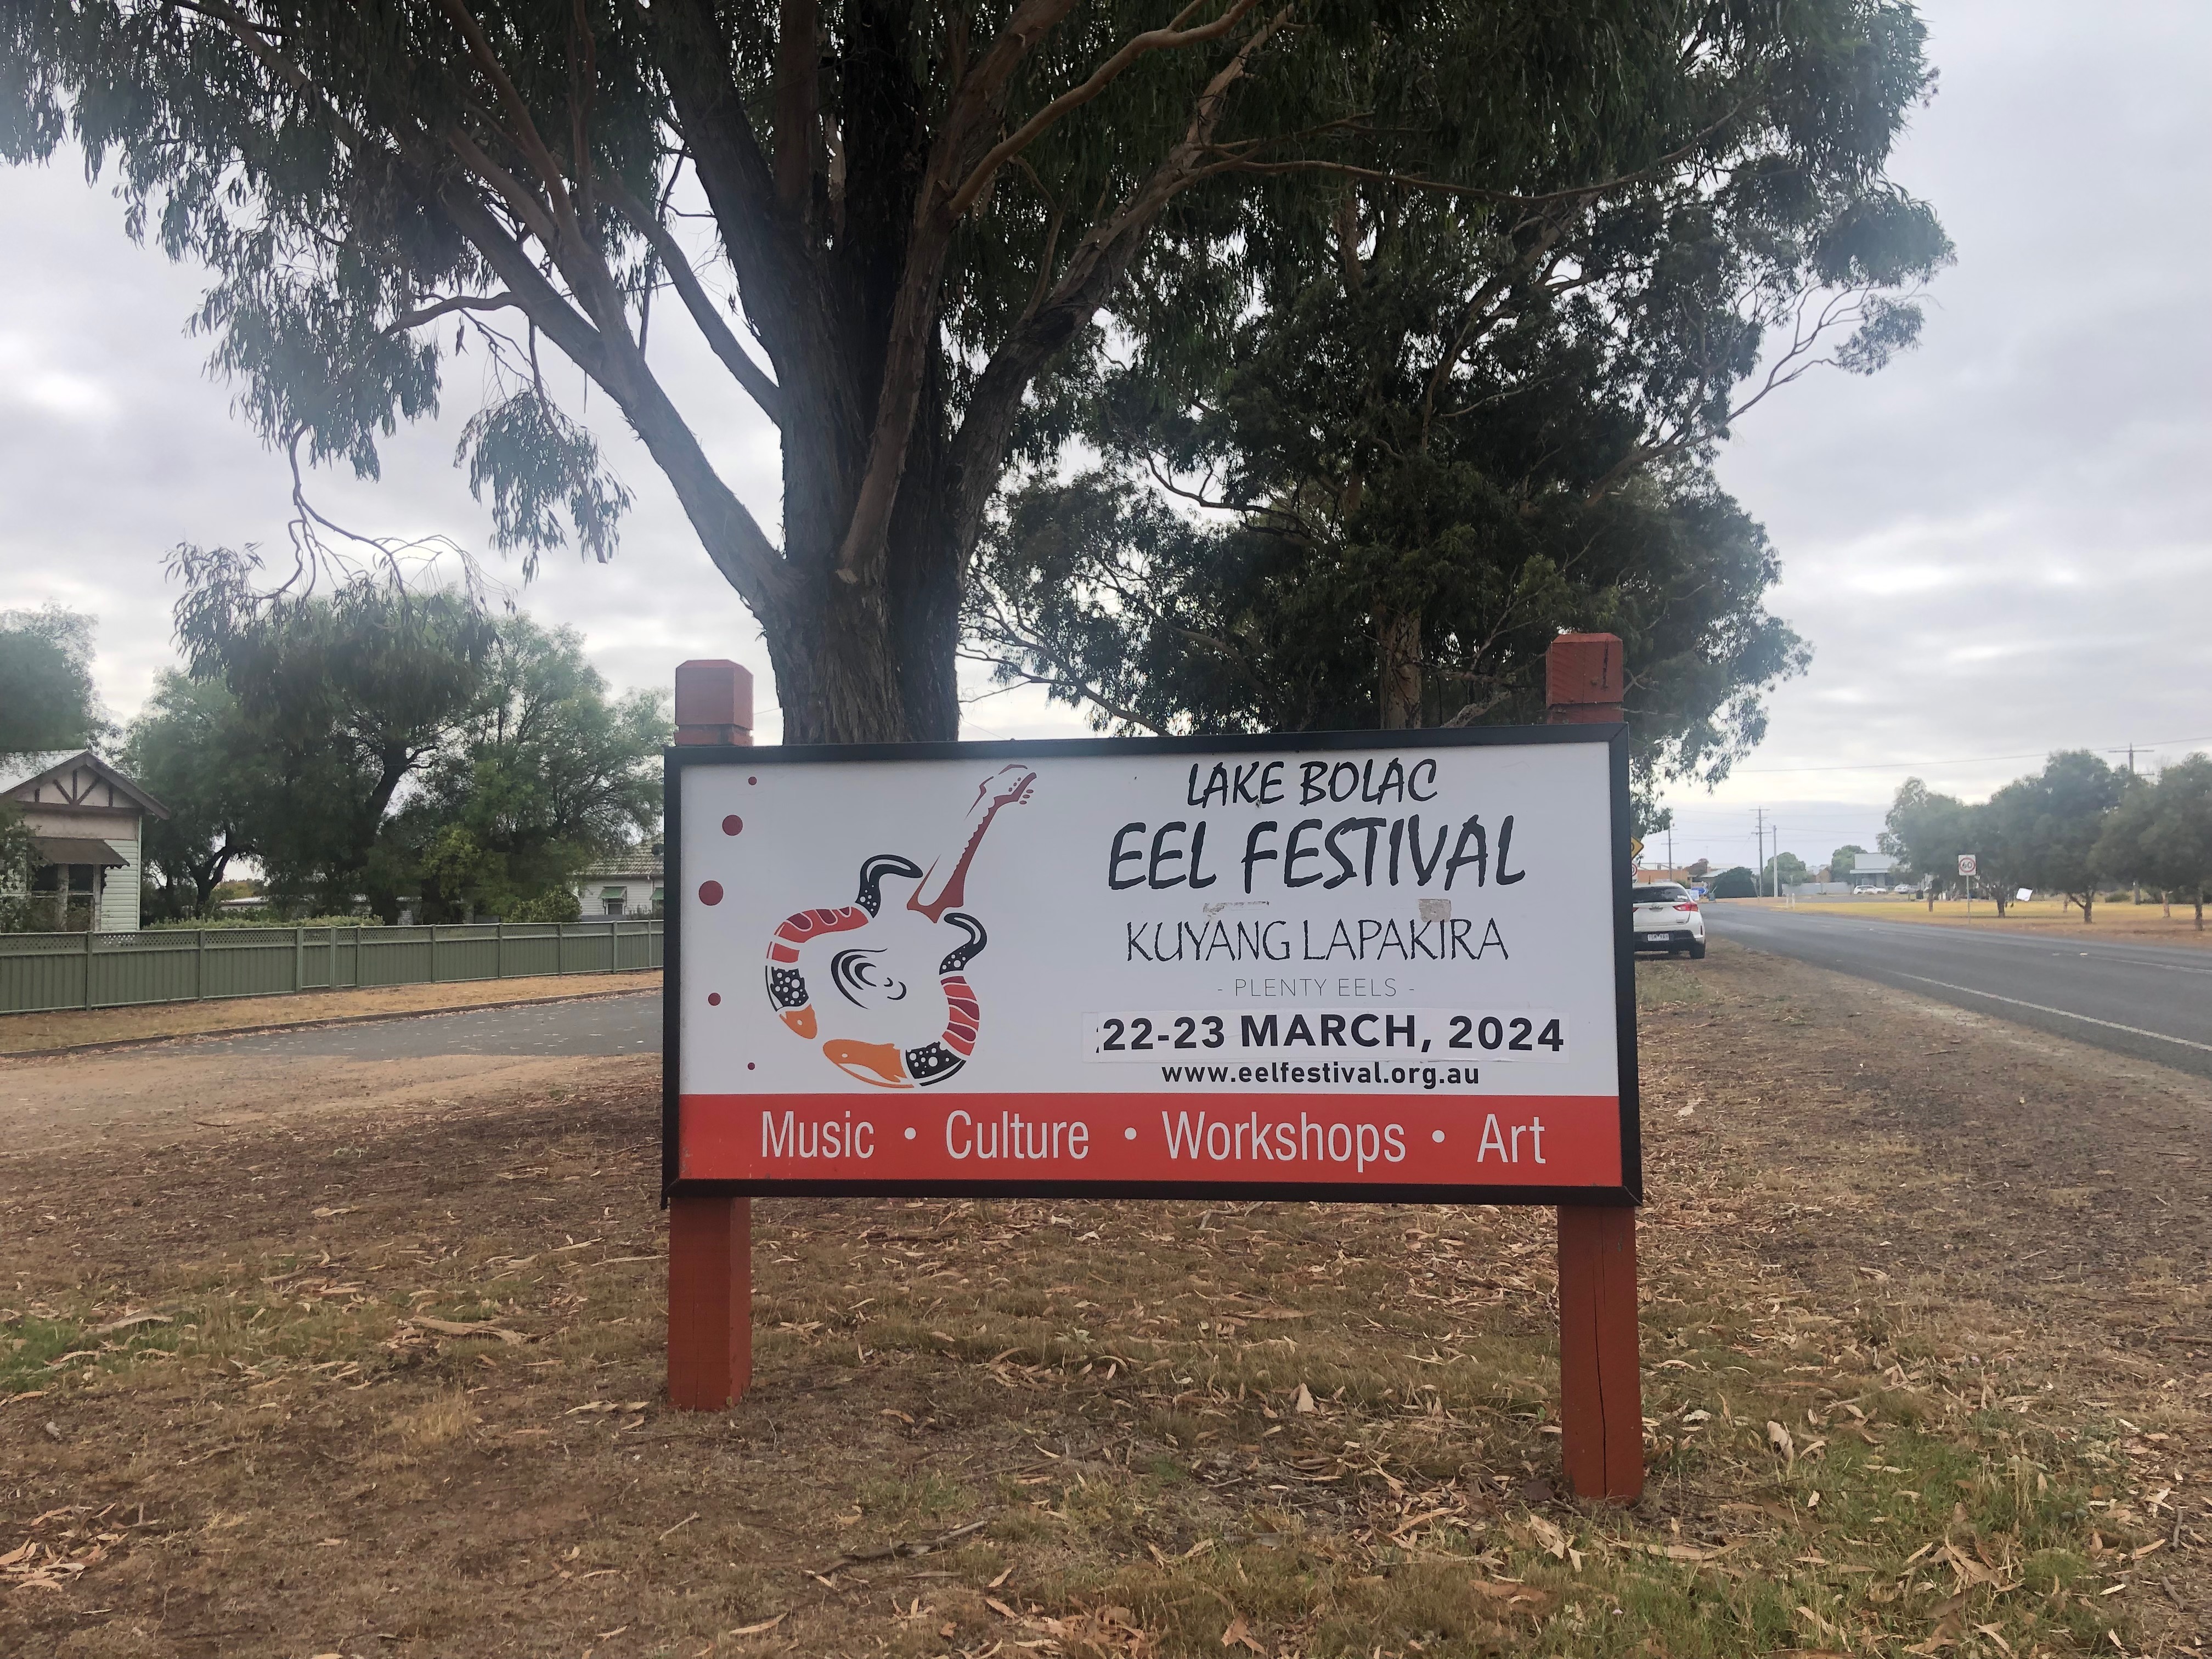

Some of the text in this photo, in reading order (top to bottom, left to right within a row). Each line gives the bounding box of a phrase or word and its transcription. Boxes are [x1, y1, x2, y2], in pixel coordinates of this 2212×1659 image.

[1187, 757, 1438, 809] LAKE BOLAC
[1108, 814, 1526, 894] EEL FESTIVAL
[1126, 918, 1509, 962] KUYANG LAPAKIRA
[1235, 978, 1327, 997] PLENTY
[1338, 978, 1397, 997] EELS
[1103, 1013, 1564, 1053] 22-23 MARCH, 2024
[1161, 1061, 1479, 1090] www.eelfestival.org.au
[761, 1110, 1547, 1173] Music Culture Workshops Art
